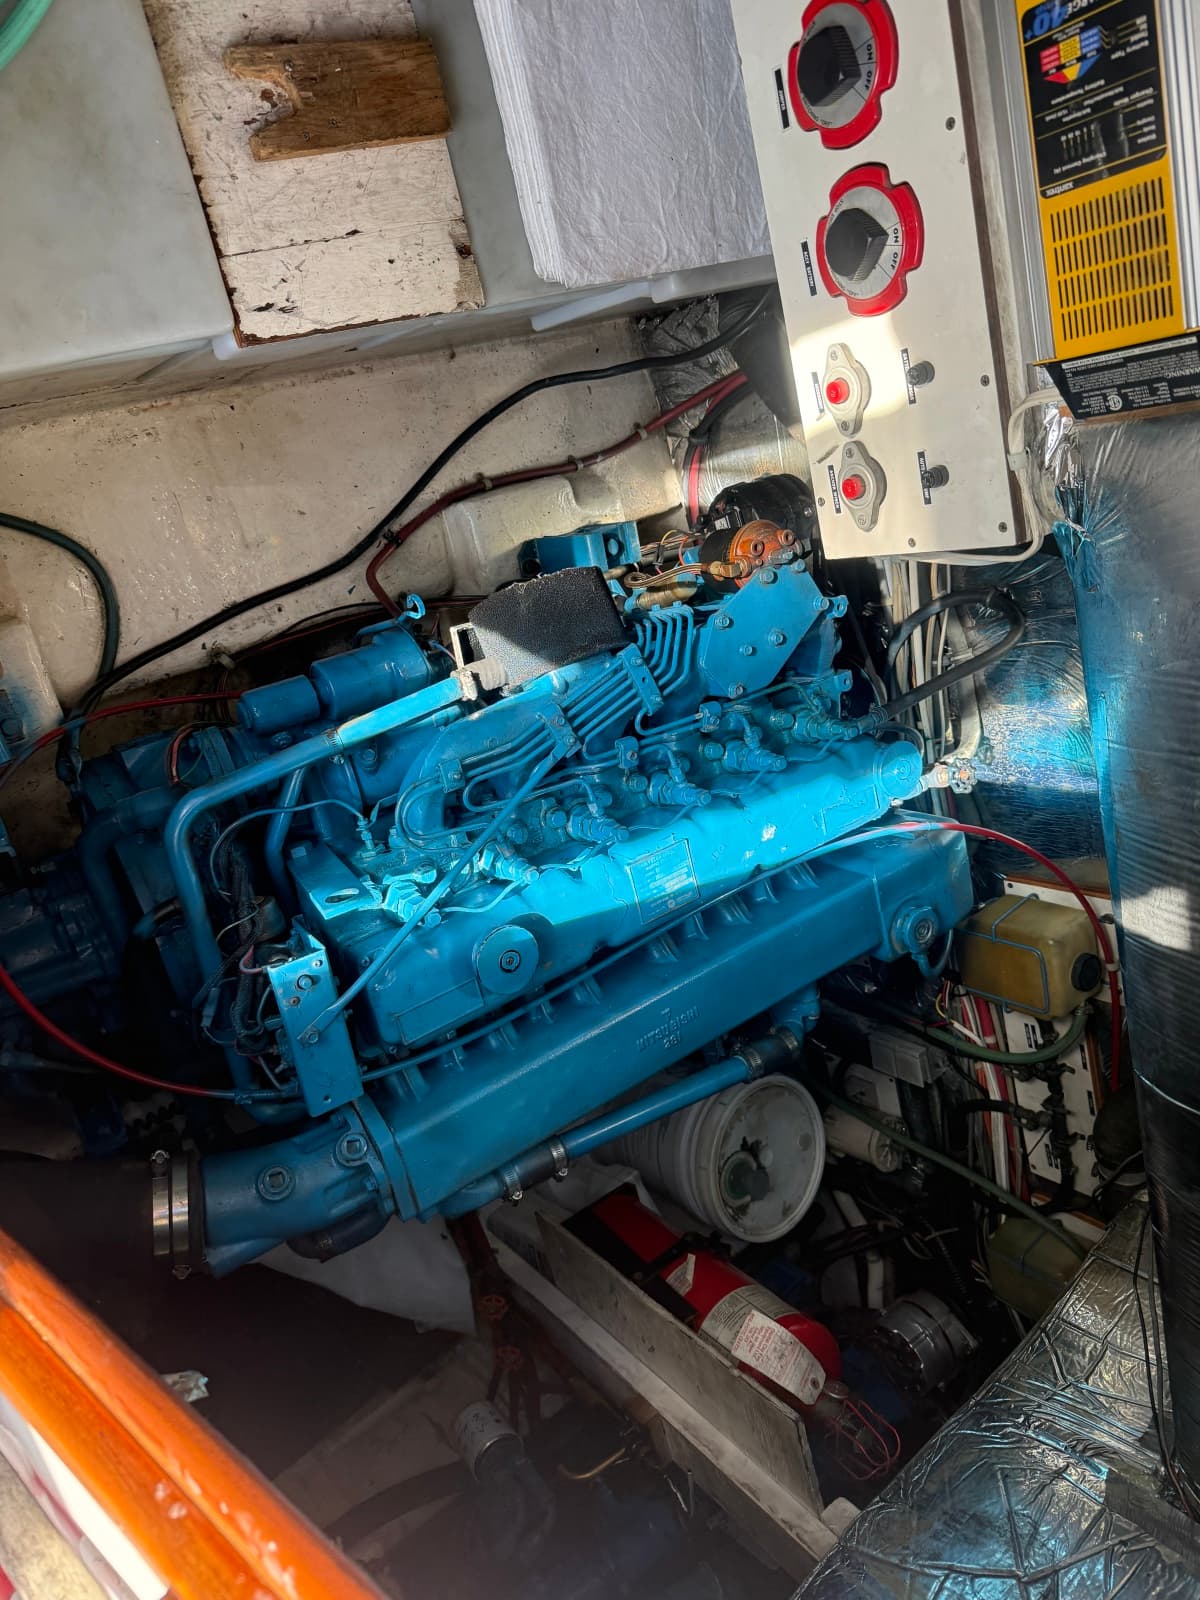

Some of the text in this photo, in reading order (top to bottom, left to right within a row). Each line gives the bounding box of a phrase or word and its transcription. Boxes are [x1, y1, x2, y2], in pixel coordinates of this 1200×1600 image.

[867, 44, 873, 60] ON
[864, 71, 872, 90] OFF
[1046, 181, 1074, 197] xantrex
[893, 228, 899, 243] ON
[891, 252, 899, 270] OFF
[636, 1006, 698, 1053] MITSUBISHI
